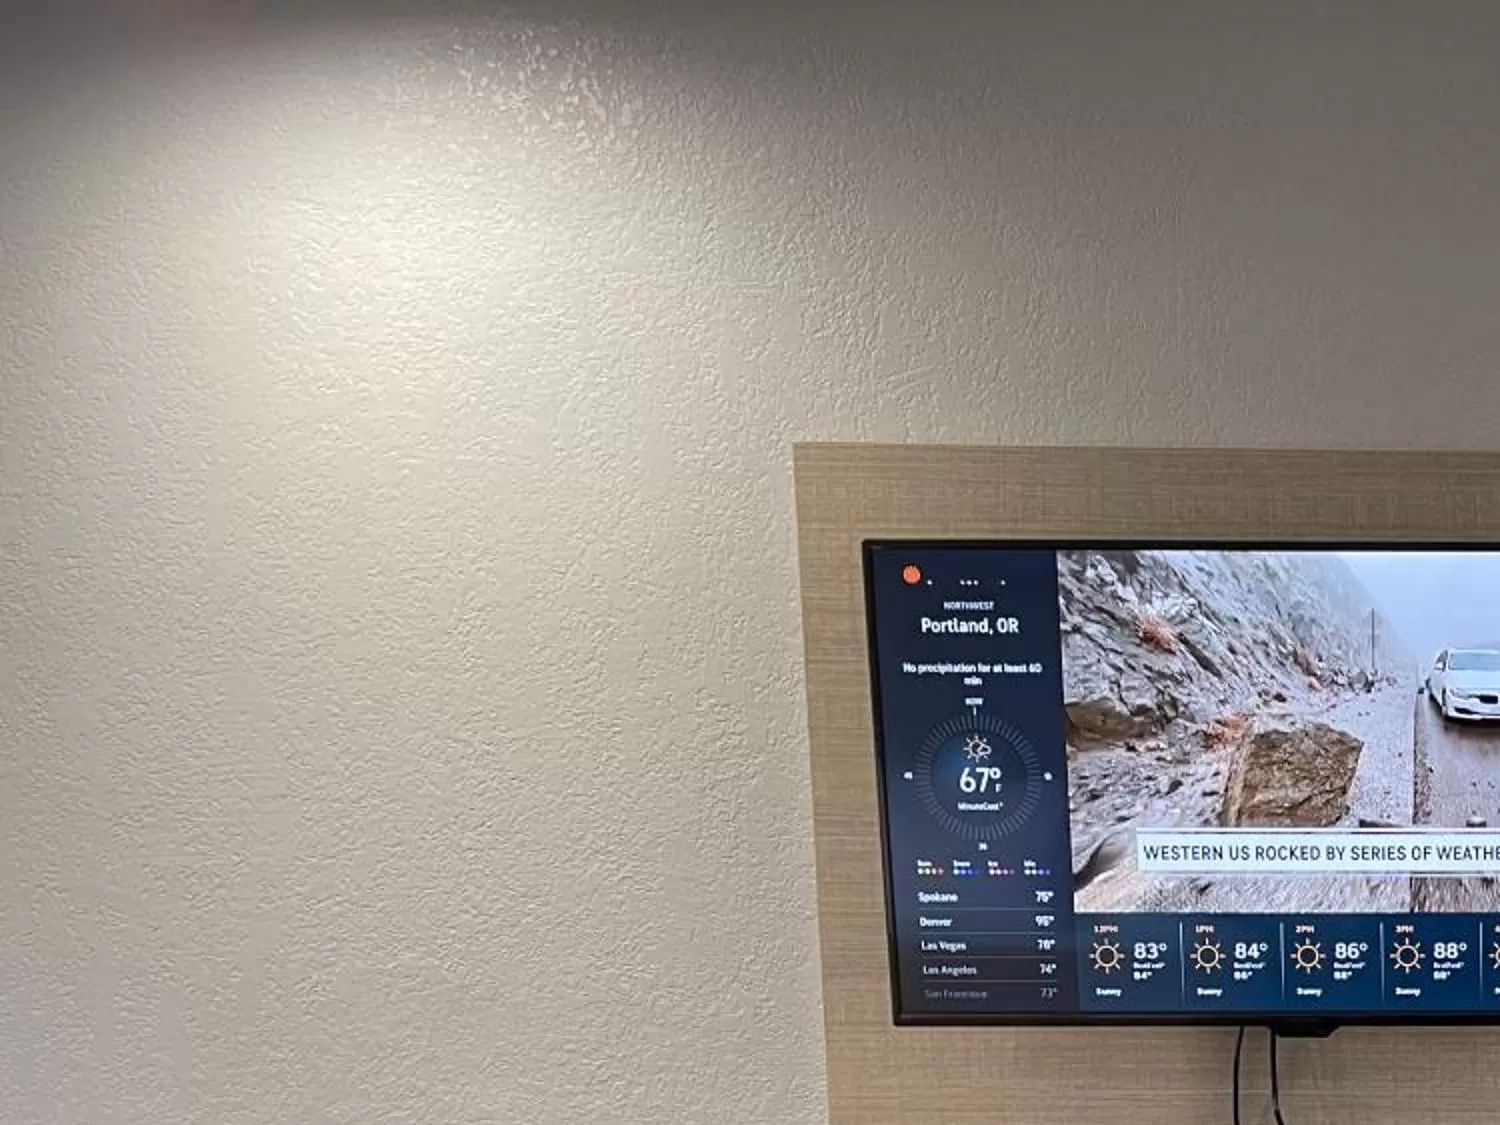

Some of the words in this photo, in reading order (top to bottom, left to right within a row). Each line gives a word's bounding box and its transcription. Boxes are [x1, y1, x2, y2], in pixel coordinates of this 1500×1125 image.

[921, 617, 993, 635] Portland,
[996, 617, 1019, 633] OR
[903, 662, 917, 673] No
[1143, 845, 1223, 861] WESTERN
[1228, 845, 1250, 861] US
[1255, 845, 1321, 861] ROCKED
[1326, 845, 1346, 861] BY
[1350, 845, 1407, 861] SERIES
[1411, 845, 1431, 860] OF
[921, 941, 938, 952] Las
[939, 941, 967, 953] Vegas
[1133, 941, 1169, 959] 83°
[1234, 941, 1269, 959] 84°
[1334, 941, 1369, 959] 86°
[1433, 941, 1468, 959] 88°
